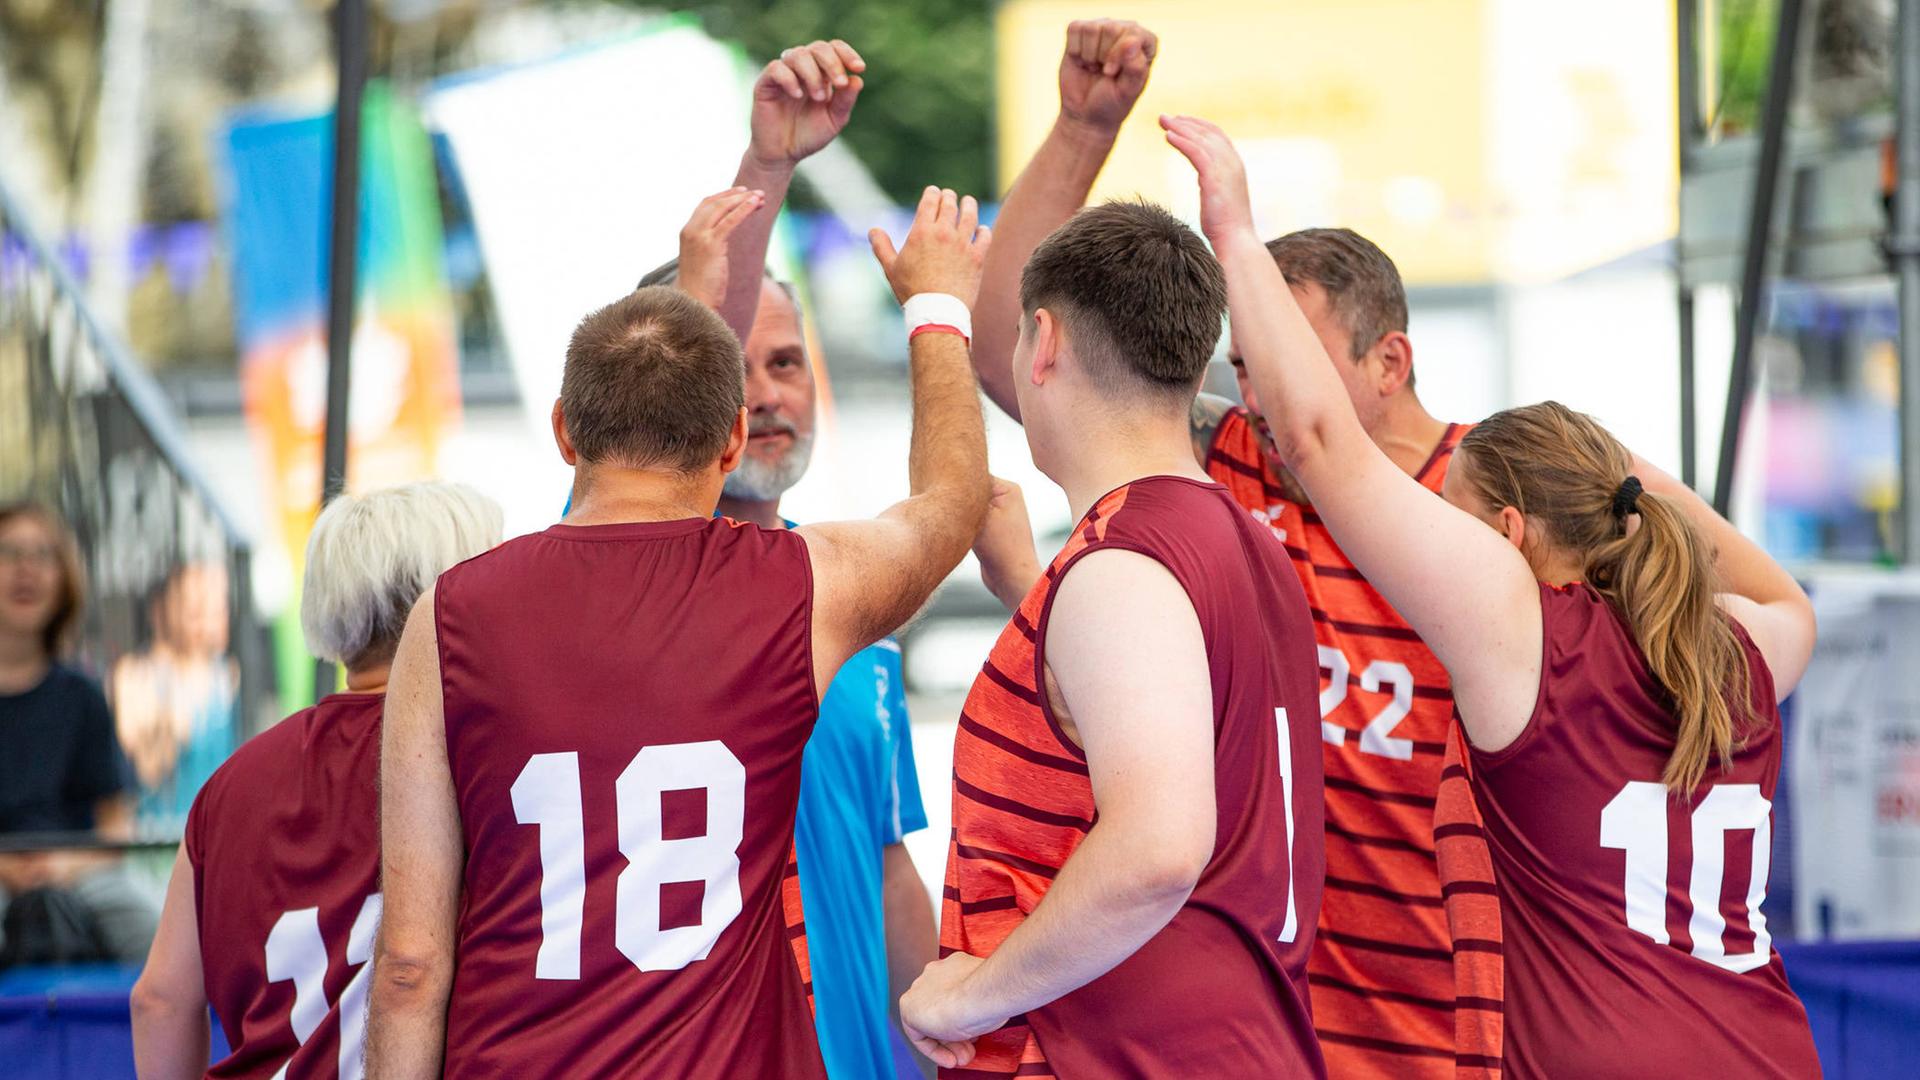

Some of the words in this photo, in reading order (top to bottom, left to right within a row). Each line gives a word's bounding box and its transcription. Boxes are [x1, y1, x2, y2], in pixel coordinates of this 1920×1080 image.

[1316, 643, 1414, 761] 22
[510, 740, 746, 980] 18
[1600, 780, 1772, 974] 10
